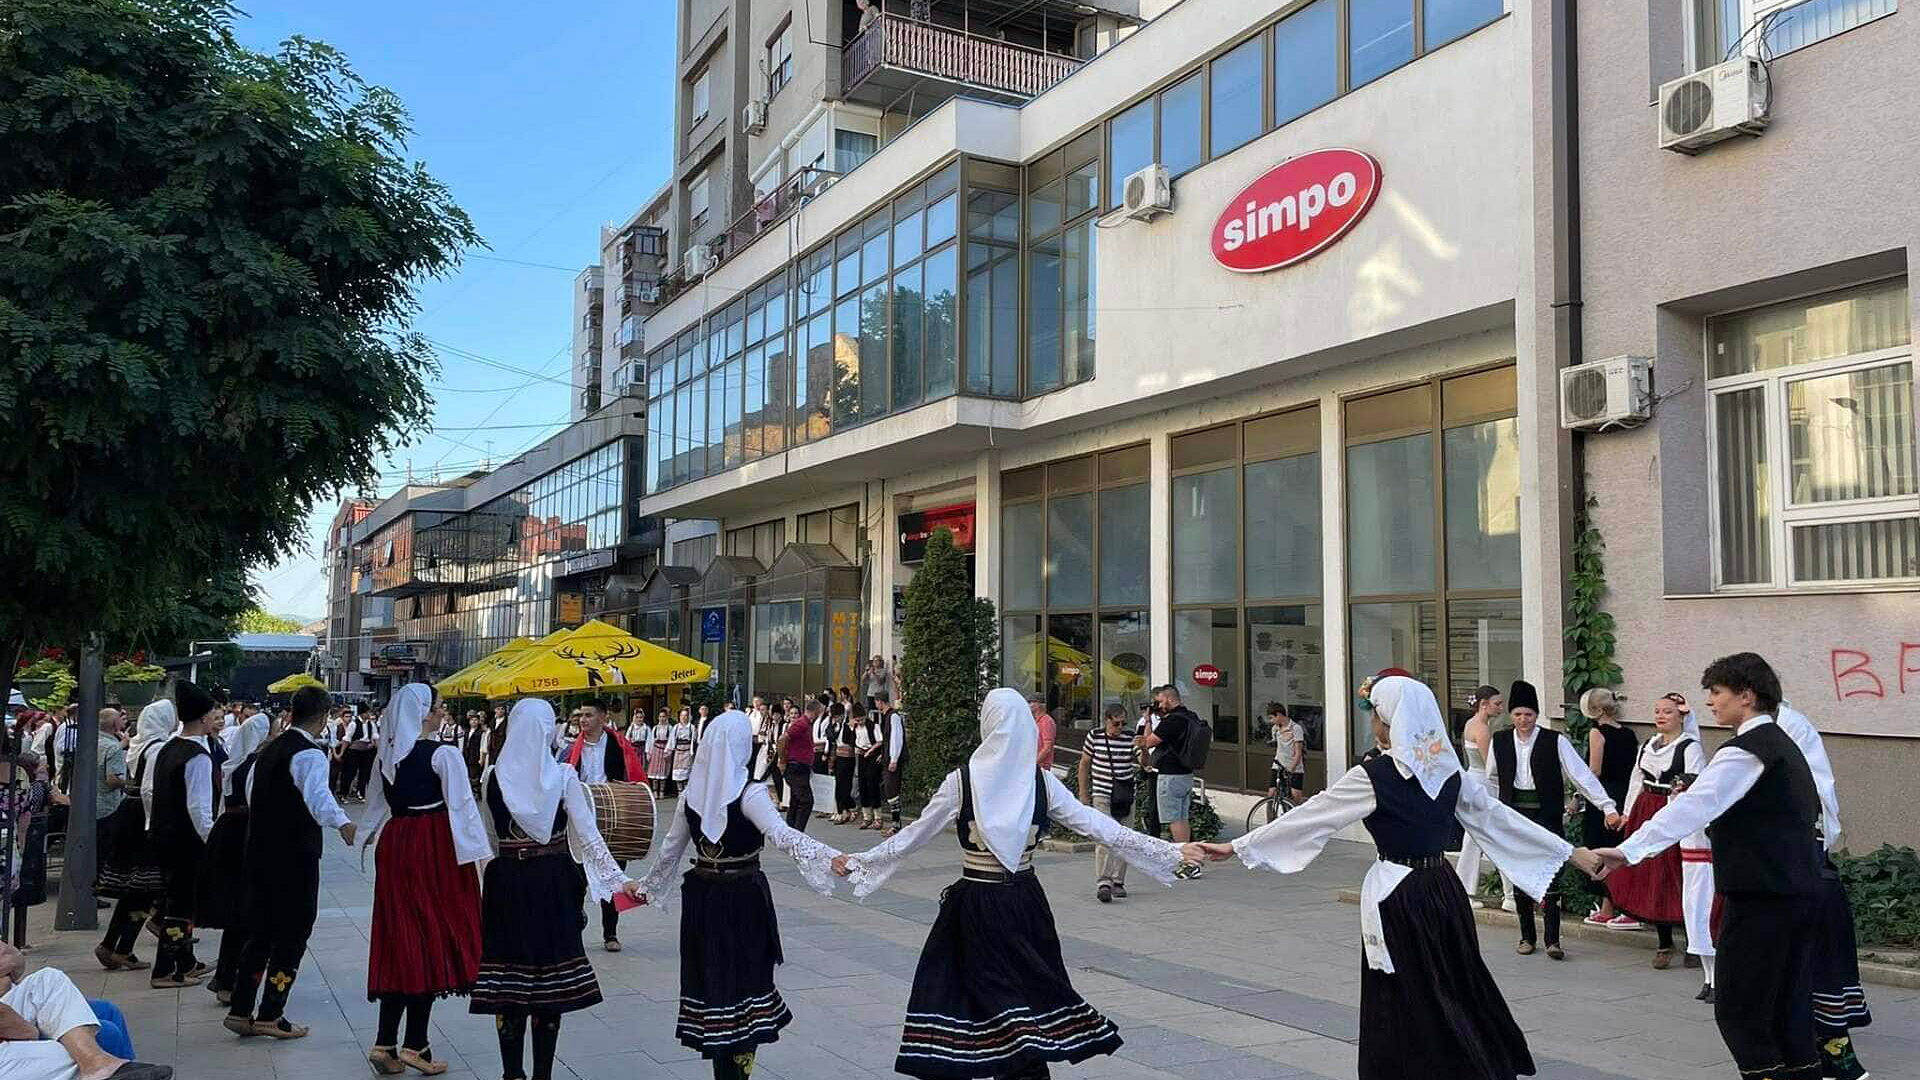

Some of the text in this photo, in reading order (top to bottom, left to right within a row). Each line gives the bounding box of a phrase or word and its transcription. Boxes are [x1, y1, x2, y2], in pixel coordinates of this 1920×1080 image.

[1223, 171, 1357, 252] simpo
[1194, 668, 1218, 681] simpo
[531, 677, 560, 688] 1756
